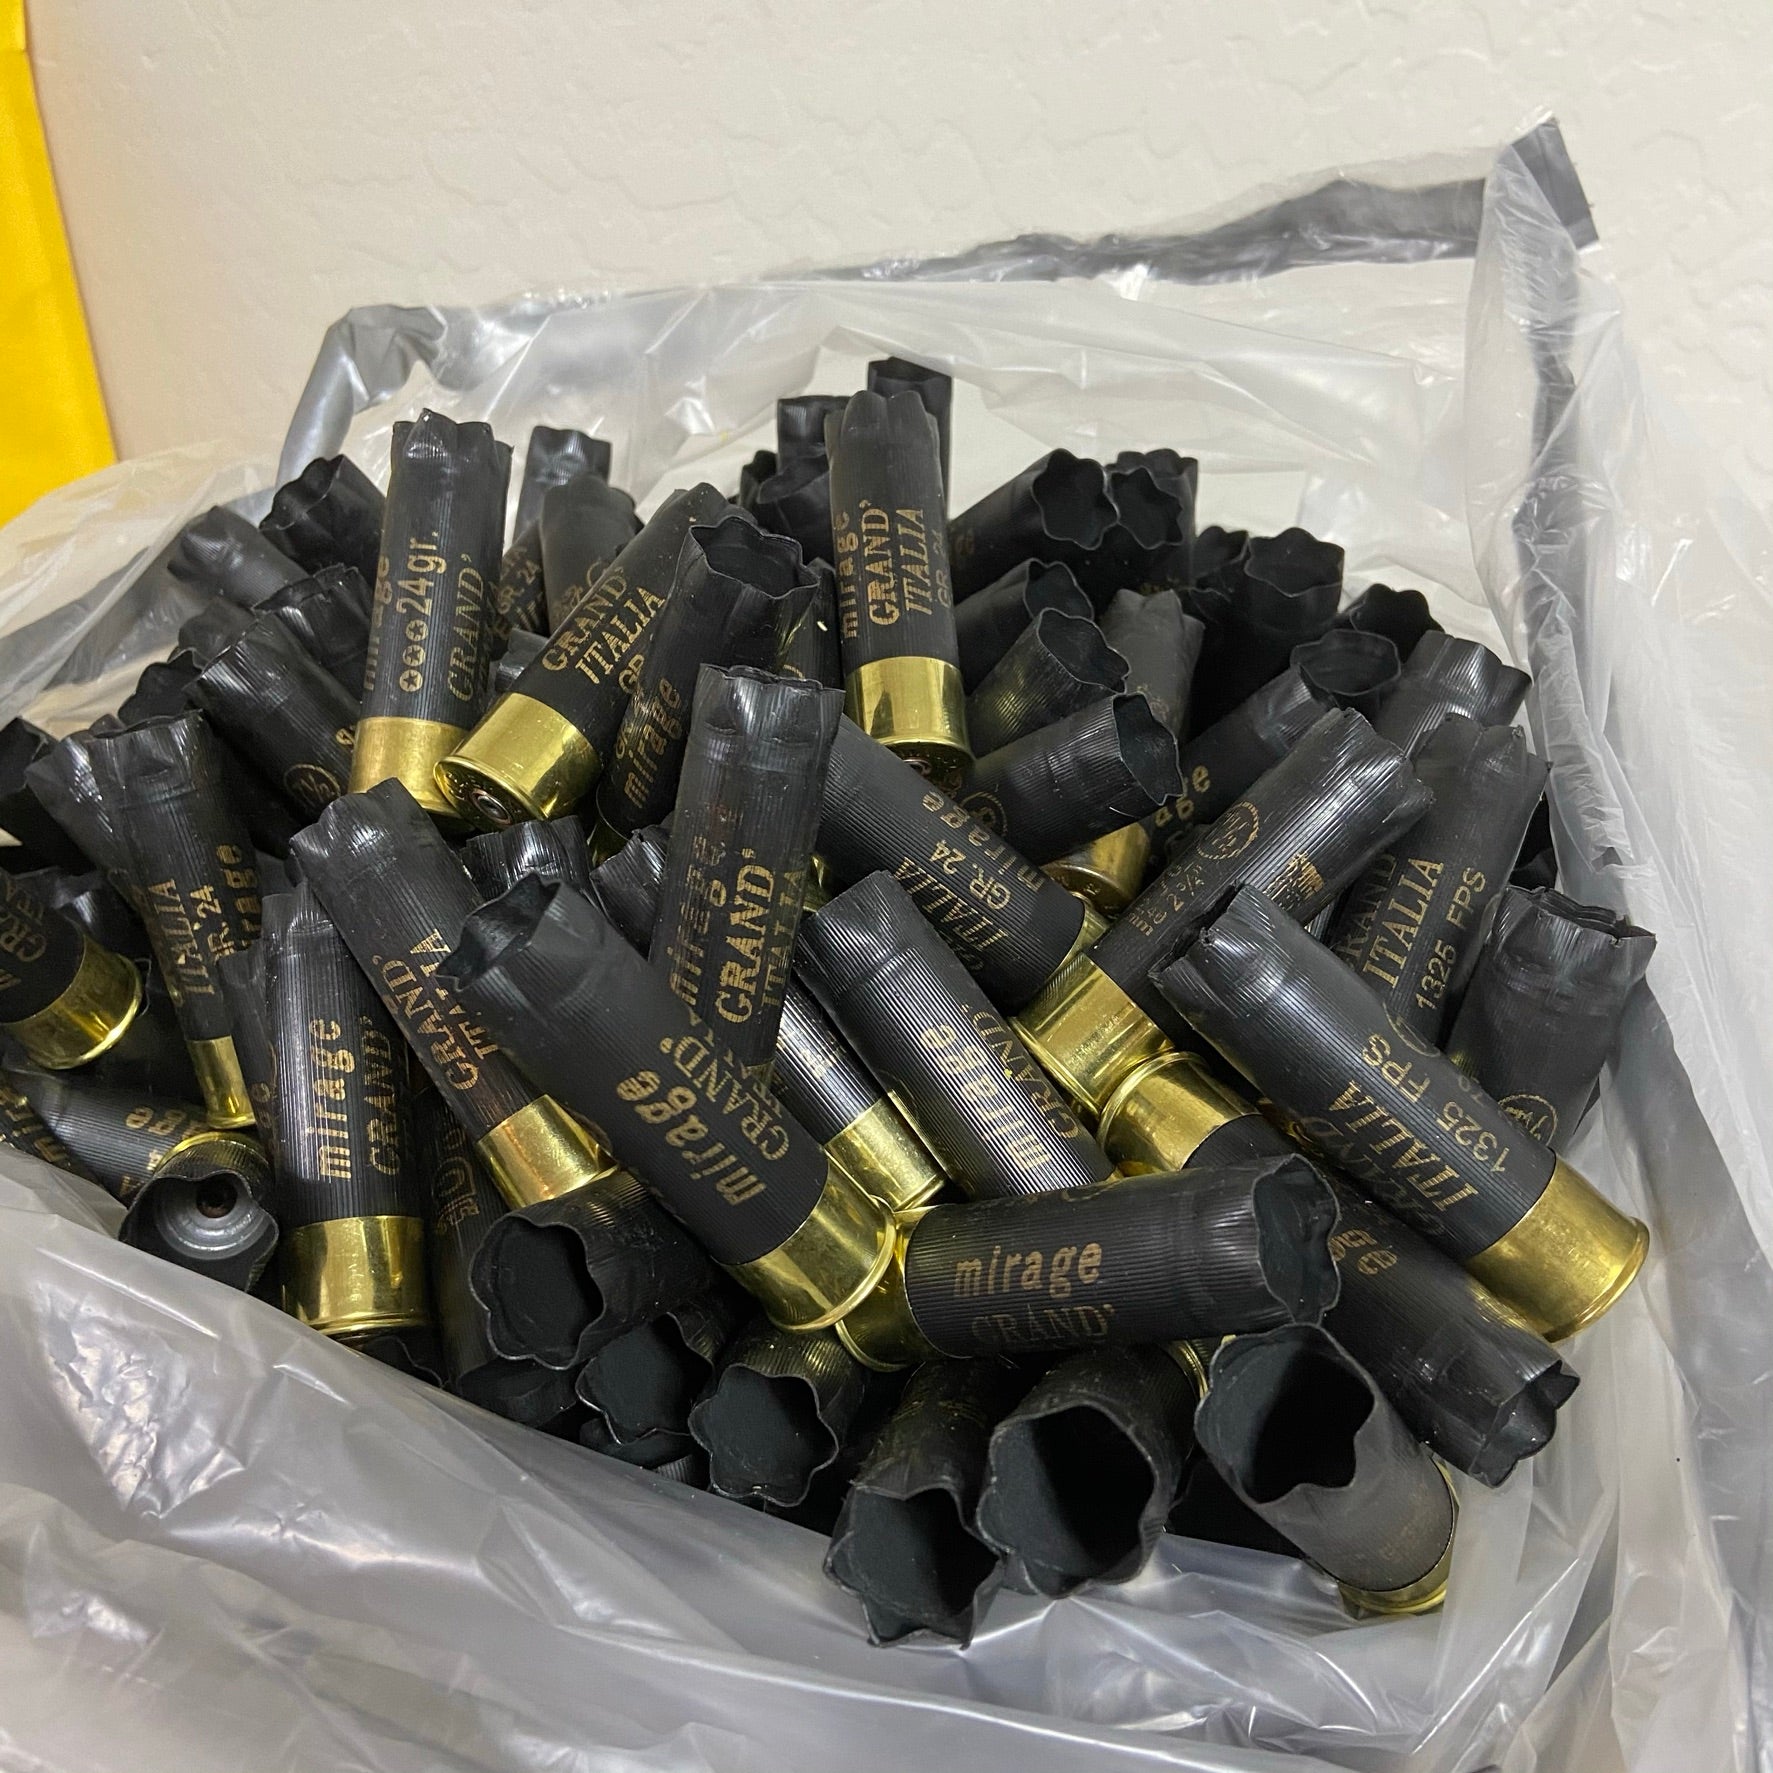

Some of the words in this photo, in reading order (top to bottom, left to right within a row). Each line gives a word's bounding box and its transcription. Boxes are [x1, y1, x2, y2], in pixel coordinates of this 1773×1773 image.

[895, 507, 934, 617] ITALIA
[574, 586, 667, 685] ITALIA
[1362, 857, 1445, 989] ITALIA
[1414, 939, 1457, 1011] 1325
[1445, 866, 1487, 930] FPS
[305, 1017, 356, 1182] mirage
[1361, 1032, 1432, 1104] FPS
[615, 1069, 768, 1207] mirage
[1327, 1079, 1480, 1213] ITALIA
[1435, 1100, 1511, 1174] 1325
[953, 1242, 1103, 1299] mirage
